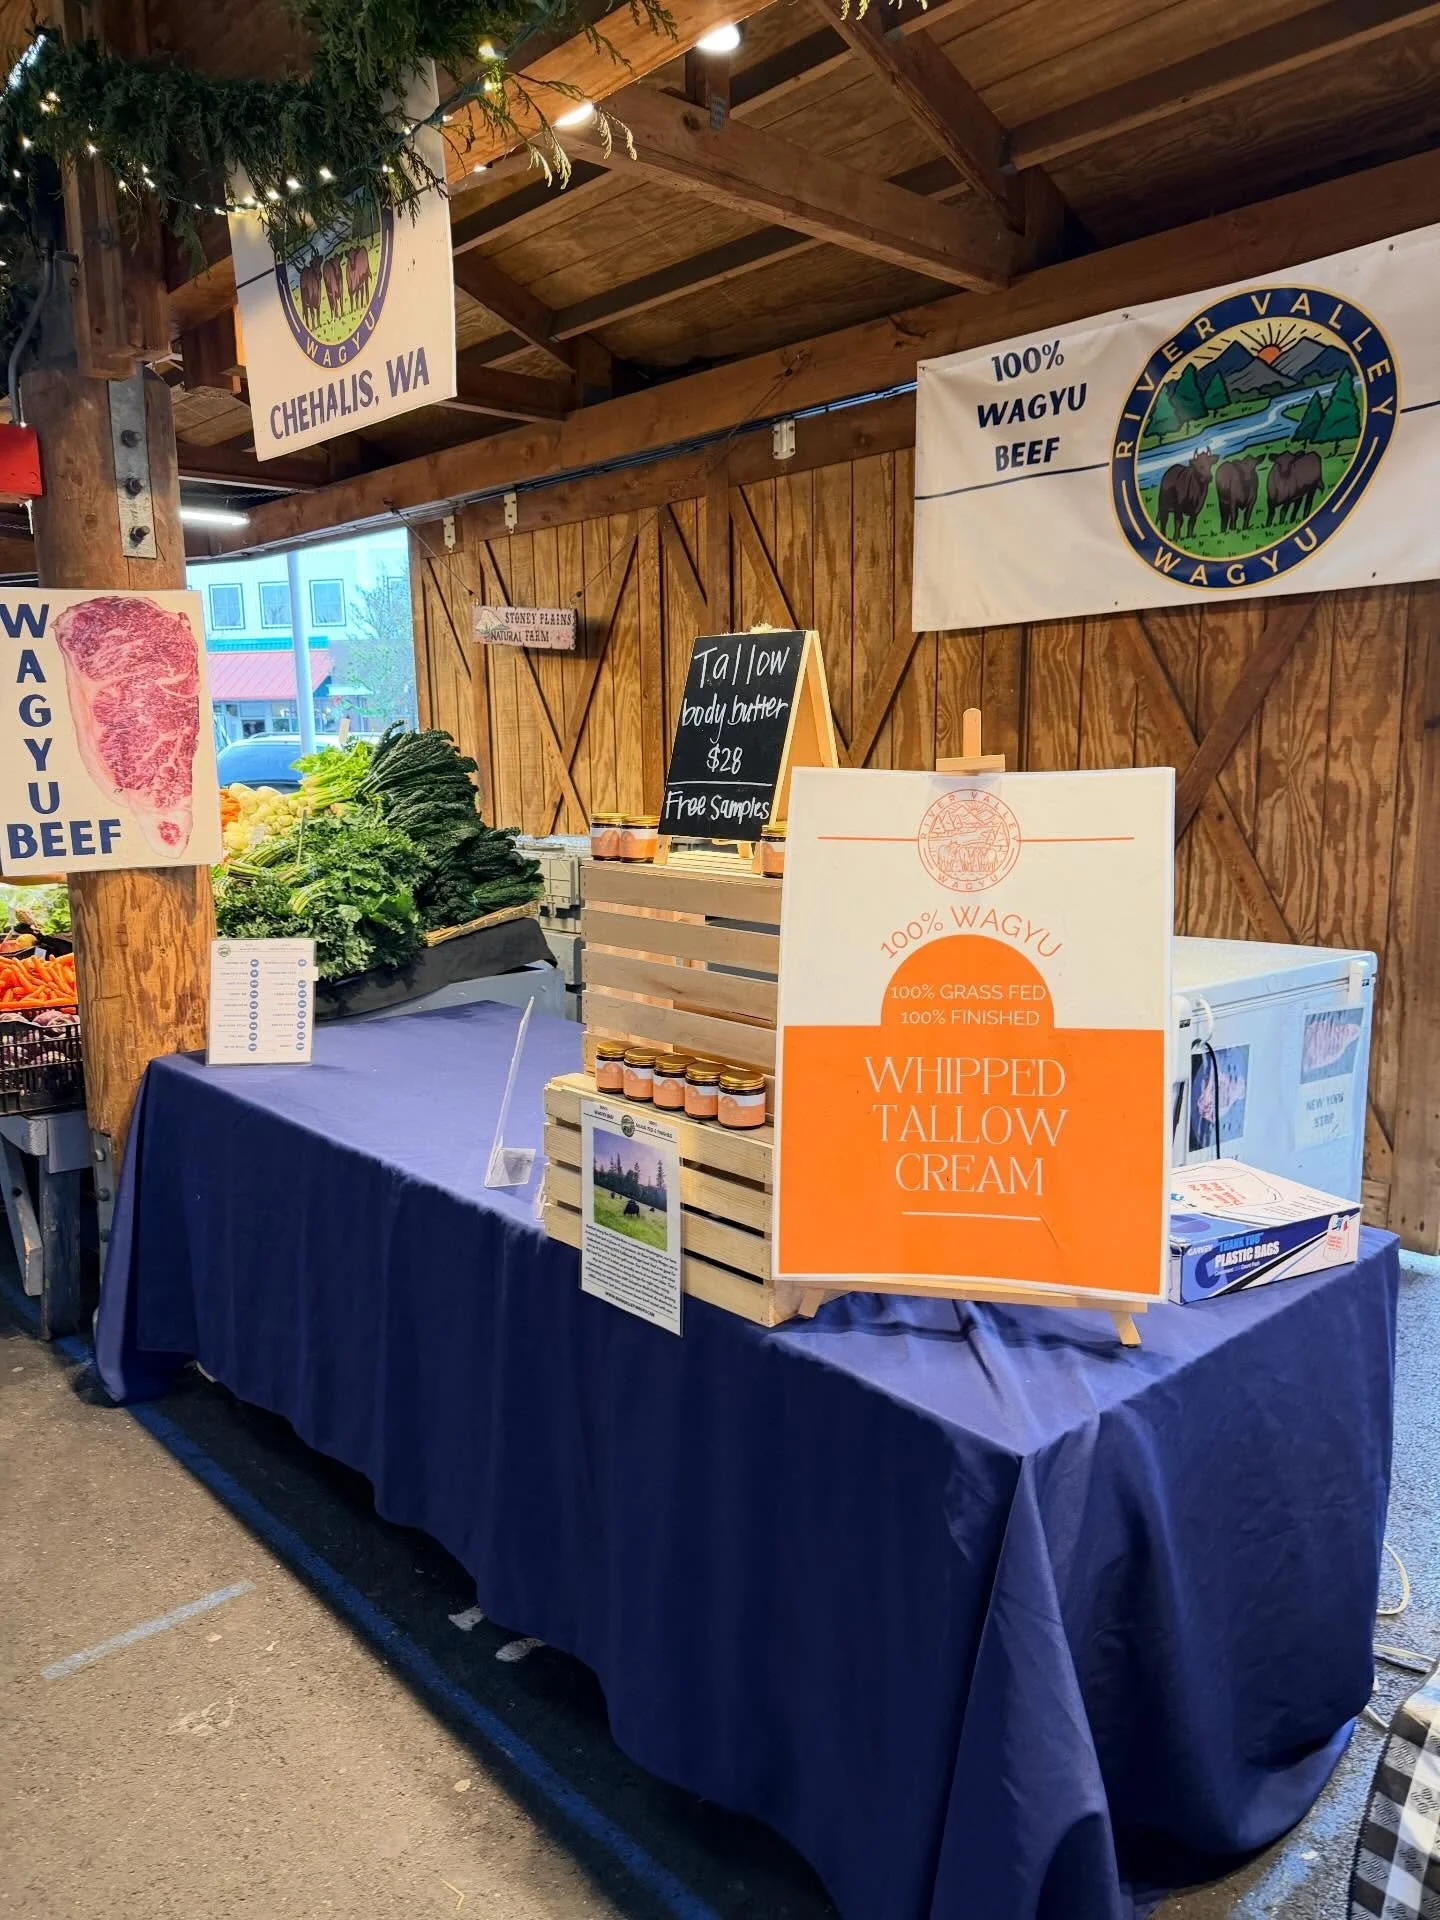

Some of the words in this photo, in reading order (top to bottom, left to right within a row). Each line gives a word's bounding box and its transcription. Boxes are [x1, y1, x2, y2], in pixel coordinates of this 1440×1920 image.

[305, 311, 376, 367] WAGYU
[991, 340, 1065, 382] 100%
[1115, 317, 1216, 460] RIVER
[1250, 292, 1393, 416] VALLEY
[270, 370, 380, 440] CHEHALIS,
[386, 347, 430, 397] WA
[977, 383, 1087, 428] WAGYU
[995, 437, 1060, 472] BEEF
[1153, 527, 1318, 586] WAGYU
[490, 629, 522, 642] NATURAL
[525, 630, 549, 642] FARM
[505, 611, 537, 625] STONEY
[540, 613, 572, 626] PLAINS
[694, 643, 791, 689] Tallow
[0, 604, 60, 815] WAGYU
[681, 693, 727, 744] body
[728, 693, 789, 726] butter
[706, 743, 743, 775] $28
[665, 790, 707, 820] Free
[709, 795, 770, 825] Samples
[921, 794, 956, 841] RIVER
[970, 791, 1018, 842] VALLEY
[6, 819, 121, 860] BEEF
[937, 875, 999, 890] WAGYU
[880, 909, 945, 959] 100%
[950, 905, 1064, 957] WAGYU
[891, 983, 935, 1001] 100%
[940, 984, 1004, 1001] GRASS
[1008, 984, 1047, 1002] FED
[901, 1008, 947, 1025] 100%
[951, 1009, 1041, 1026] FINISHED
[863, 1056, 1067, 1098] WHIPPED
[872, 1104, 1070, 1148] TALLOW
[895, 1152, 1045, 1197] CREAM
[1214, 1246, 1254, 1269] PLASTIC
[1254, 1241, 1280, 1260] BAGS
